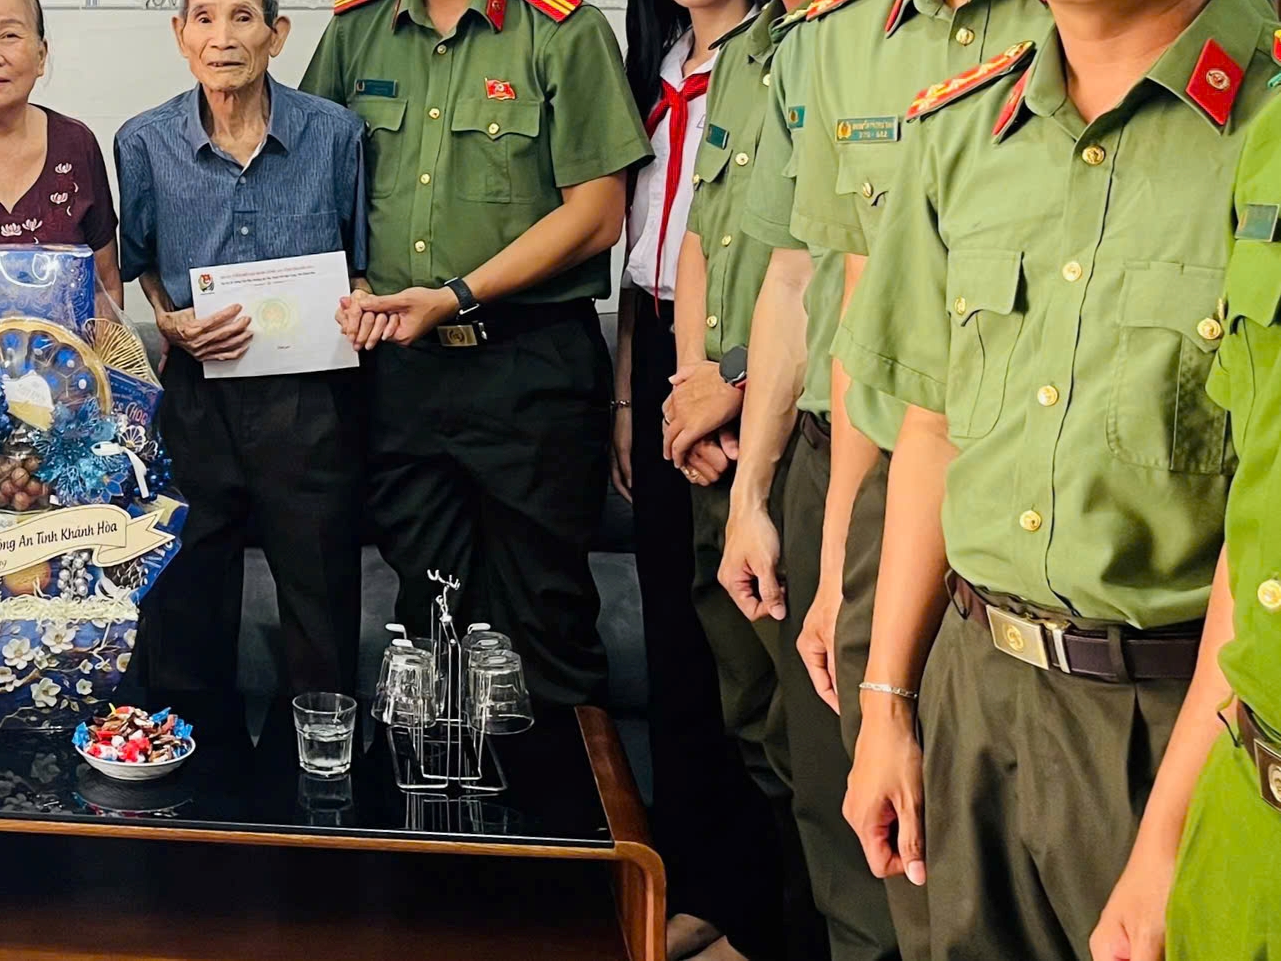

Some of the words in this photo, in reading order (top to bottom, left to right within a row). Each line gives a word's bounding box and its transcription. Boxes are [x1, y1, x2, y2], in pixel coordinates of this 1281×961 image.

[18, 534, 33, 548] An
[60, 524, 94, 541] Khánh
[97, 520, 118, 536] Hòa
